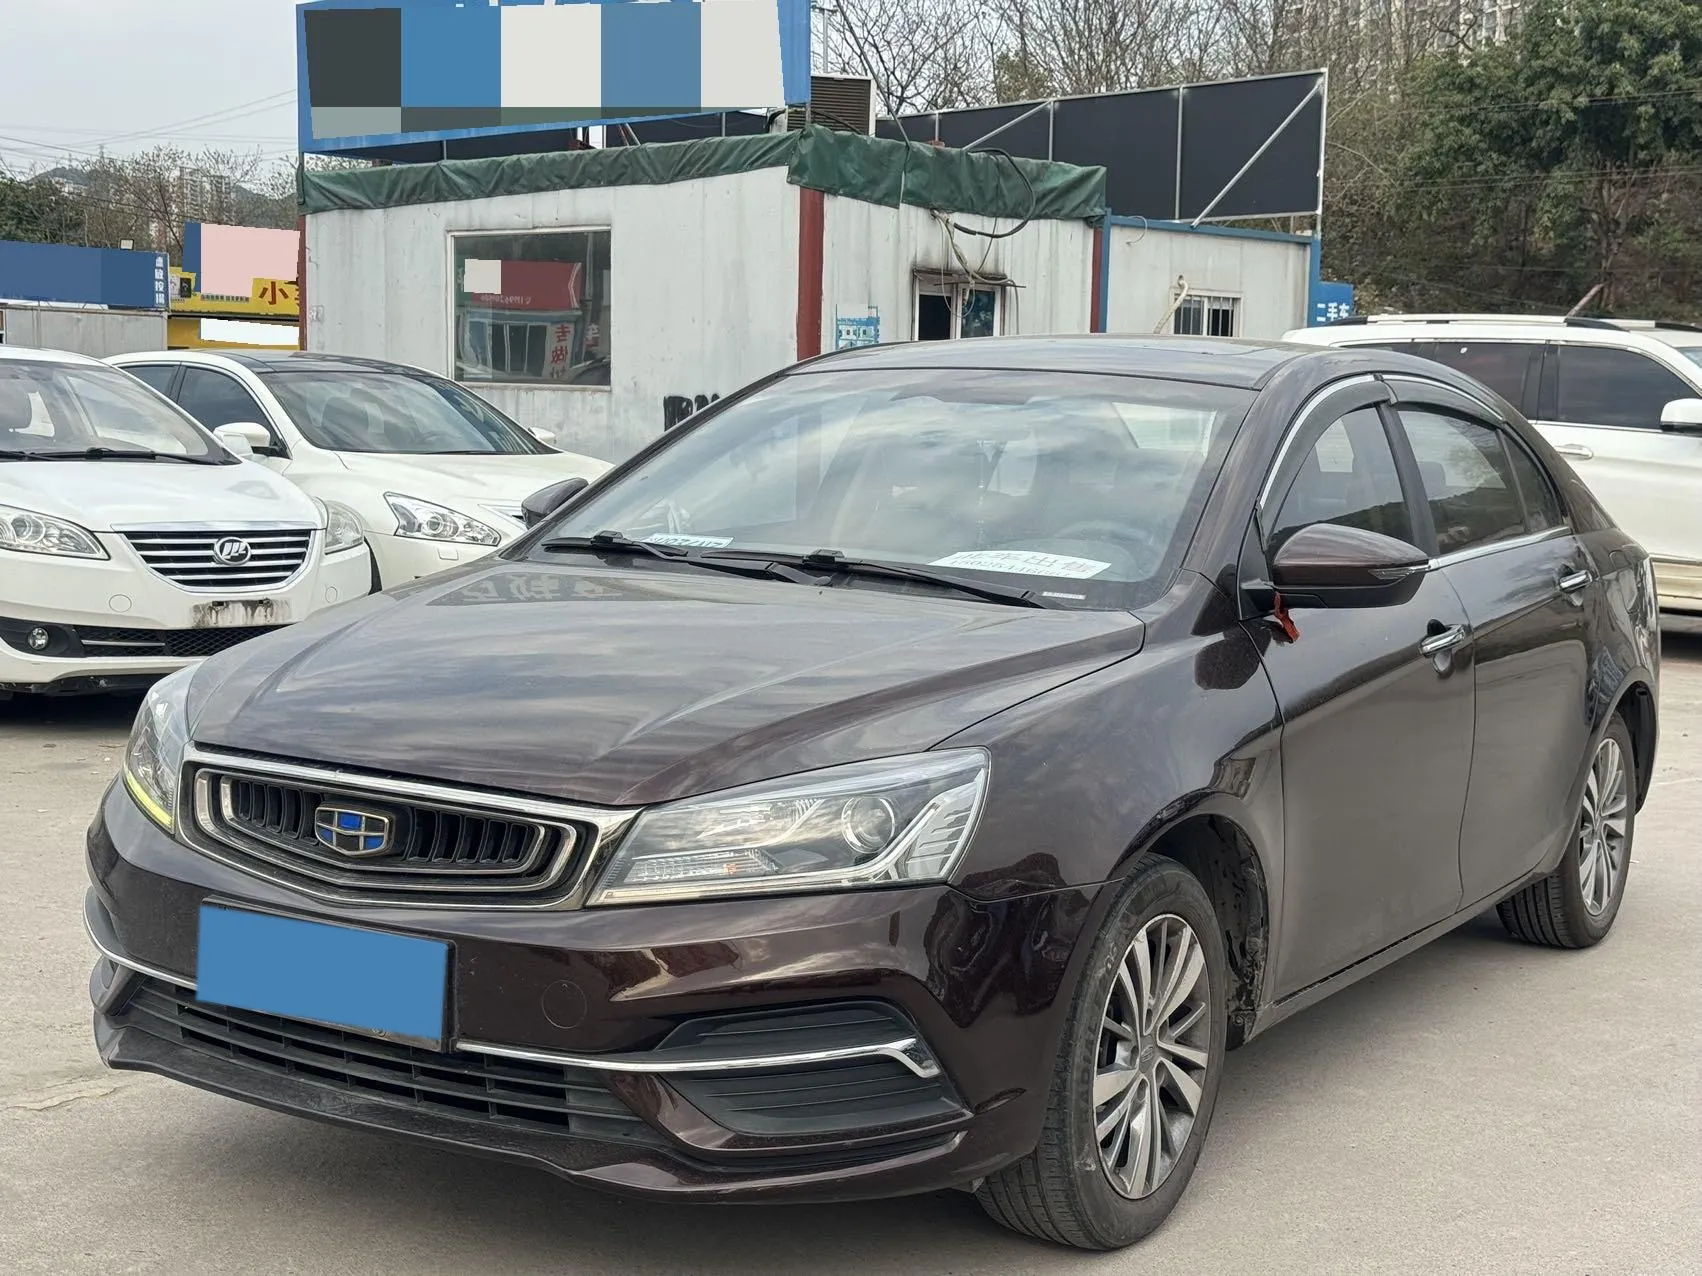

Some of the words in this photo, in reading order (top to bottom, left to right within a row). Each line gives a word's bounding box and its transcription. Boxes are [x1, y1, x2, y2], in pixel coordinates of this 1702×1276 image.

[258, 278, 299, 307] 小
[1316, 302, 1350, 321] 二手车
